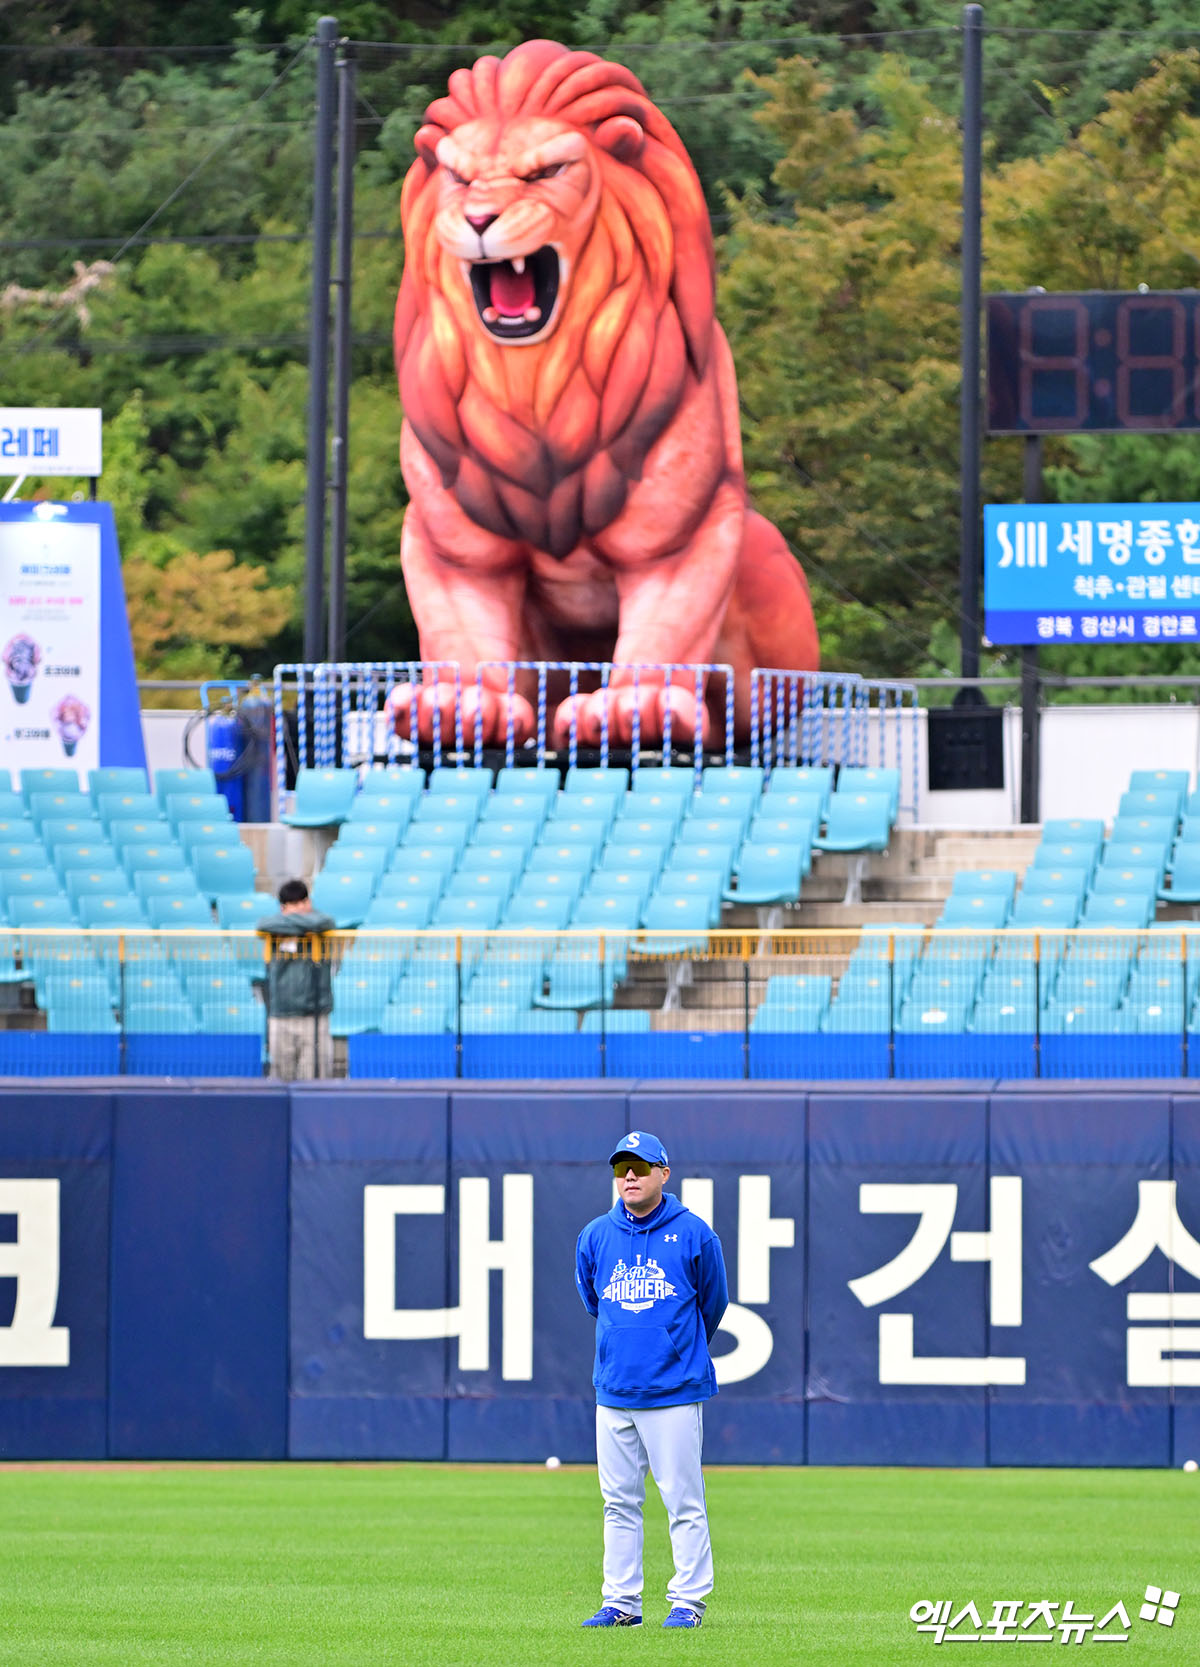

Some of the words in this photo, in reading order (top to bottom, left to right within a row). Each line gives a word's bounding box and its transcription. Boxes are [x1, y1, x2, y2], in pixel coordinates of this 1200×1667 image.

[1, 427, 59, 457] 레페
[1036, 615, 1073, 638] 경북
[1081, 615, 1135, 638] 경산시
[625, 1132, 640, 1149] S
[611, 1279, 666, 1302] HIGHER
